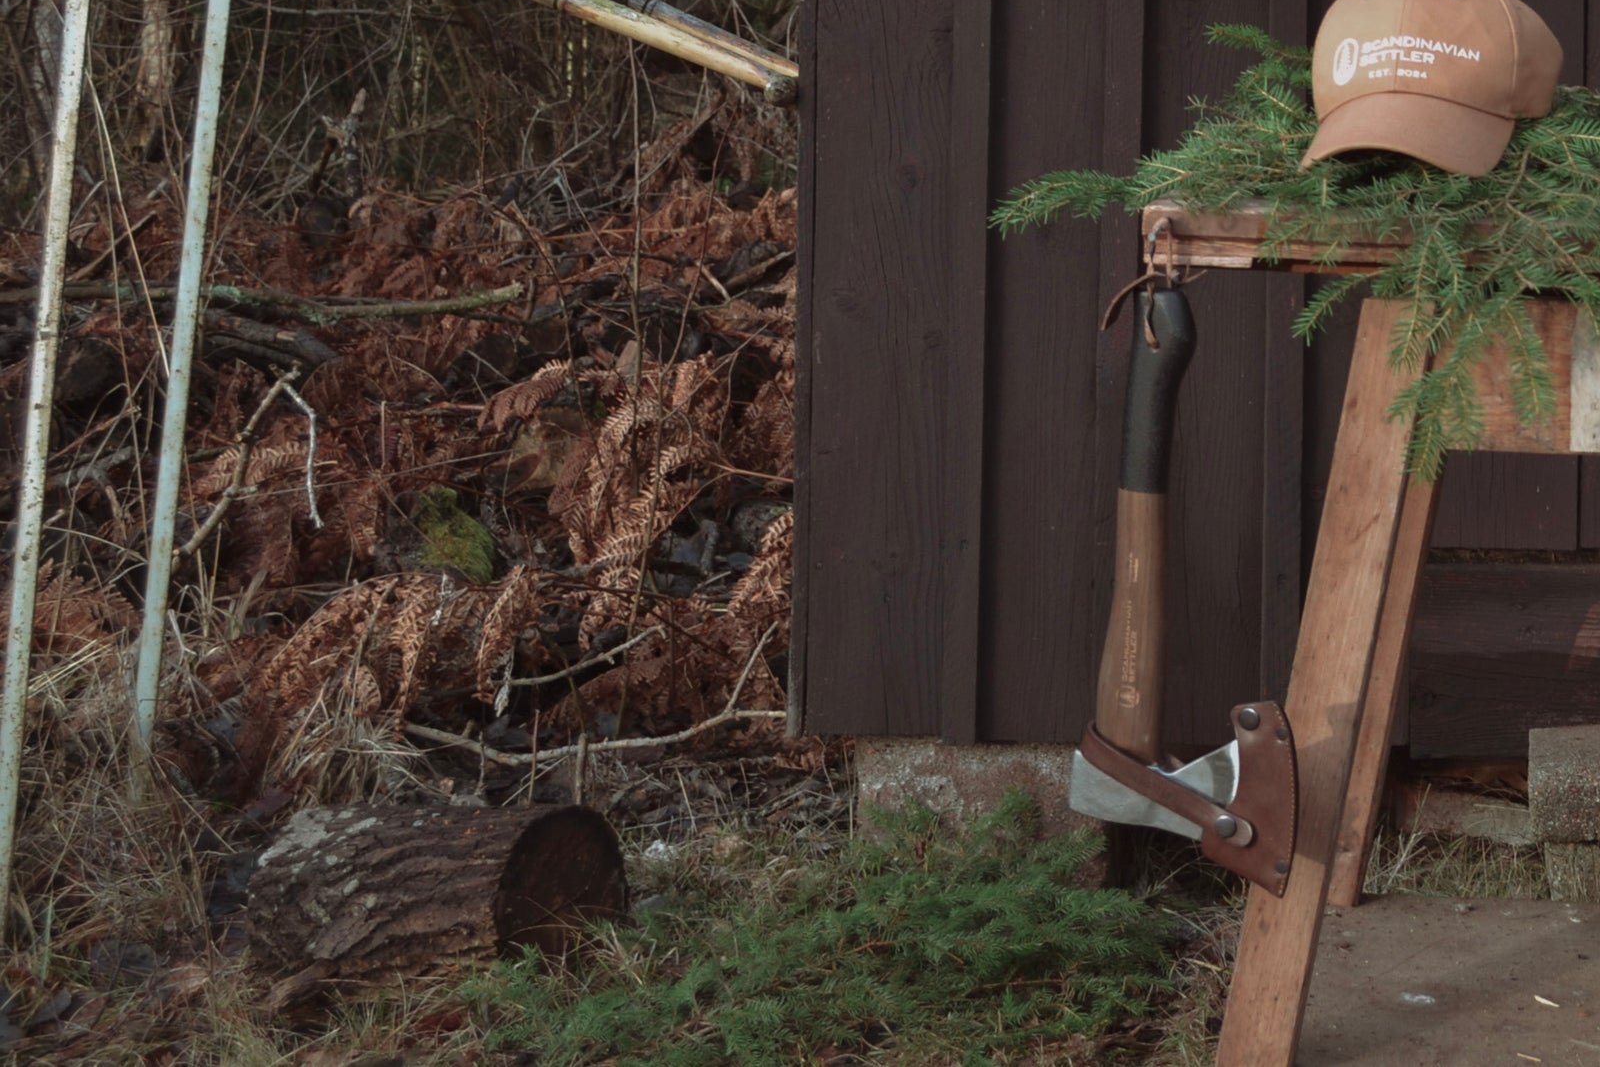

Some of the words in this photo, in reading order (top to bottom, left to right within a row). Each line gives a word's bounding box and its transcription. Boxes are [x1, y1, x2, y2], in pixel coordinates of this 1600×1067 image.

[1361, 36, 1480, 61] SCANDINAVIAN
[1359, 49, 1436, 67] SETTLER
[1368, 68, 1392, 79] EST.
[1397, 68, 1428, 79] 2024
